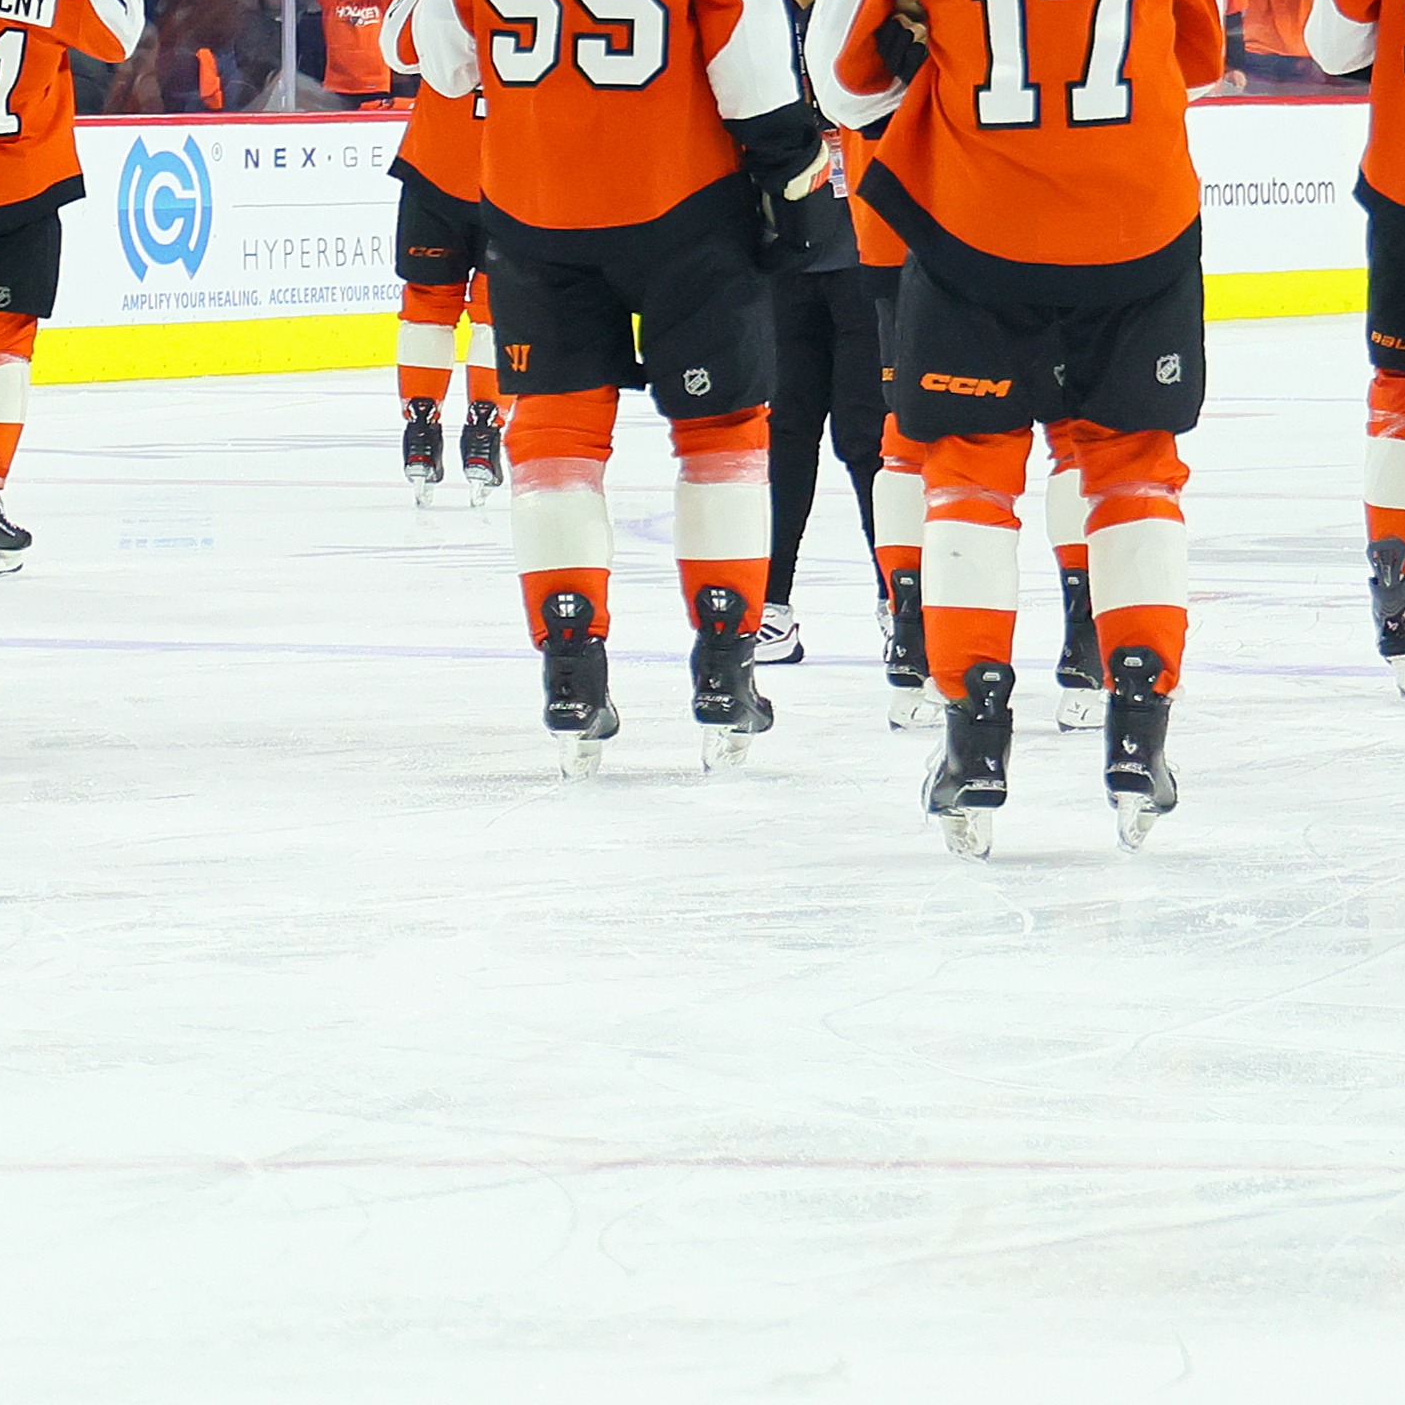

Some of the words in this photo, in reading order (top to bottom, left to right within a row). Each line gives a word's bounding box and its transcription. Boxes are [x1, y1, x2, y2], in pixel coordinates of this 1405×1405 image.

[1198, 177, 1335, 206] manauto.com
[407, 244, 448, 258] CC
[122, 292, 170, 311] AMPLIFY
[174, 291, 206, 310] YOUR
[210, 290, 261, 309] HEALING.
[269, 287, 338, 307] ACCELERATE
[342, 286, 370, 304] YOUR
[372, 285, 406, 303] RECO
[920, 371, 1012, 400] CCM
